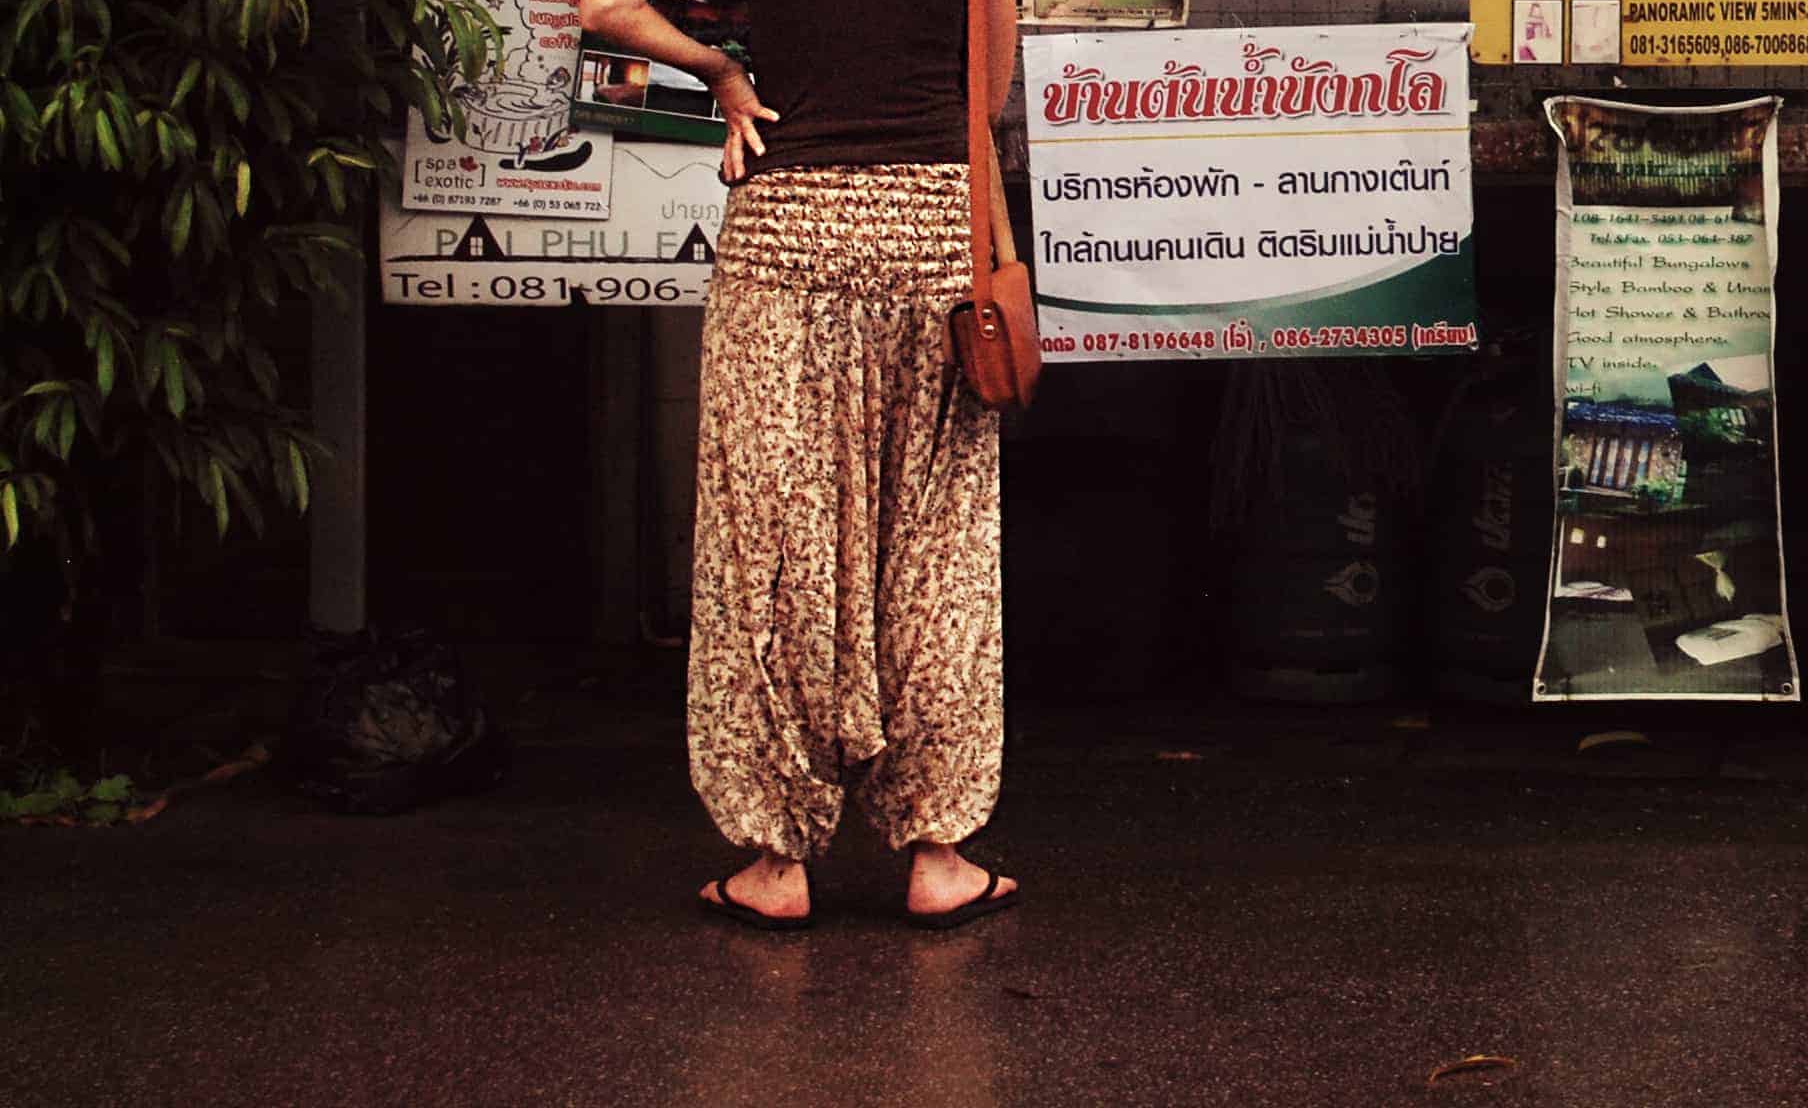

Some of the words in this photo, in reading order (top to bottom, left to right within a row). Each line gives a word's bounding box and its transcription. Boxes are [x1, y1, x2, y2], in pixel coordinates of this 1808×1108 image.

[1629, 1, 1715, 22] PANORAMIC
[1720, 1, 1757, 21] VIEW
[425, 156, 457, 172] spa
[425, 174, 474, 189] exotic
[1042, 166, 1239, 202] บริการห้องพัก
[541, 229, 628, 258] PHU
[1040, 230, 1245, 265] ใกล้ถนนคนเดิน
[1258, 218, 1459, 259] ติดริมแม่น้ำปาย
[1652, 256, 1750, 272] Bungalows
[391, 272, 455, 300] Tel
[1569, 282, 1611, 296] Style
[1622, 282, 1693, 294] Bamboo
[1702, 282, 1718, 293] &
[1606, 306, 1673, 319] Shower
[1683, 307, 1698, 318] &
[1083, 331, 1215, 351] 087-8196648
[1272, 326, 1406, 351] 086-2734305
[1567, 331, 1613, 345] Good
[1622, 332, 1728, 350] atmosphere.
[1568, 358, 1594, 369] TV
[1602, 357, 1658, 370] inside.
